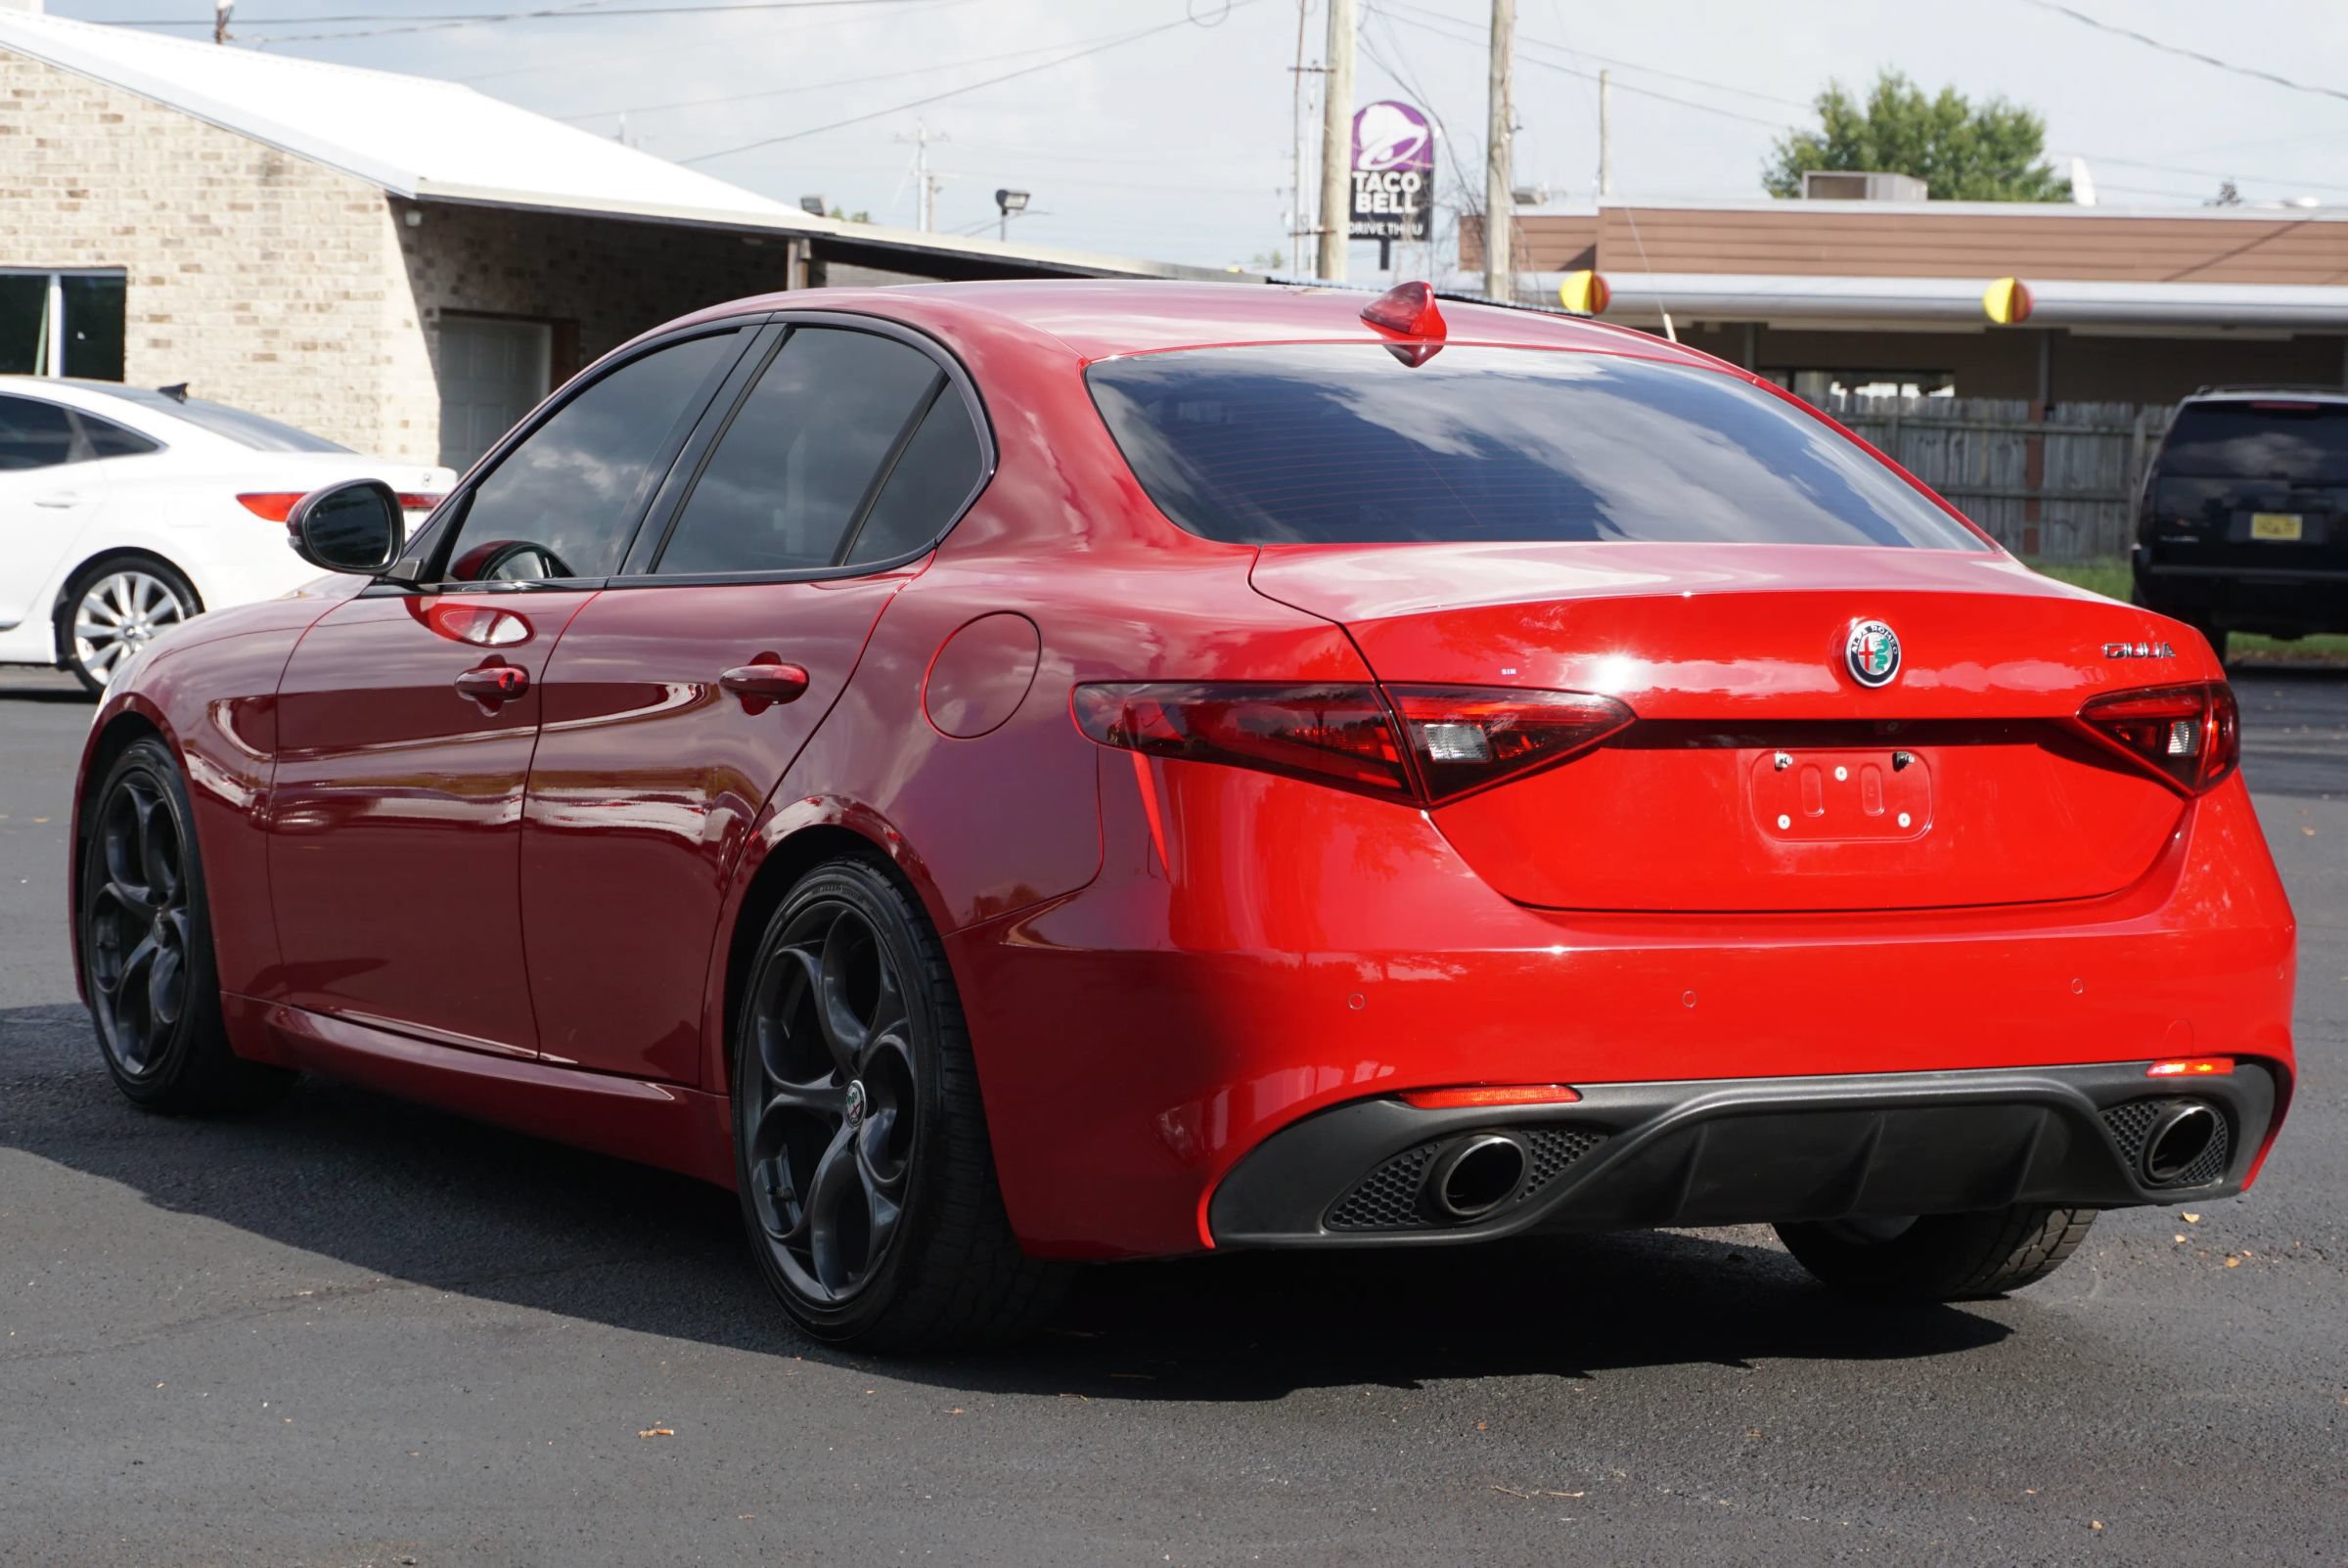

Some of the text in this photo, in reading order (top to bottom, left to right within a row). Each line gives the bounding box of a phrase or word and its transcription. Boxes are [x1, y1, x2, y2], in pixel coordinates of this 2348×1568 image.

[1352, 171, 1421, 193] TACO
[1355, 192, 1419, 213] BELL
[1347, 221, 1422, 236] DRIVE THU
[1870, 624, 1899, 654] ROMEO
[2100, 642, 2176, 658] GIULIA
